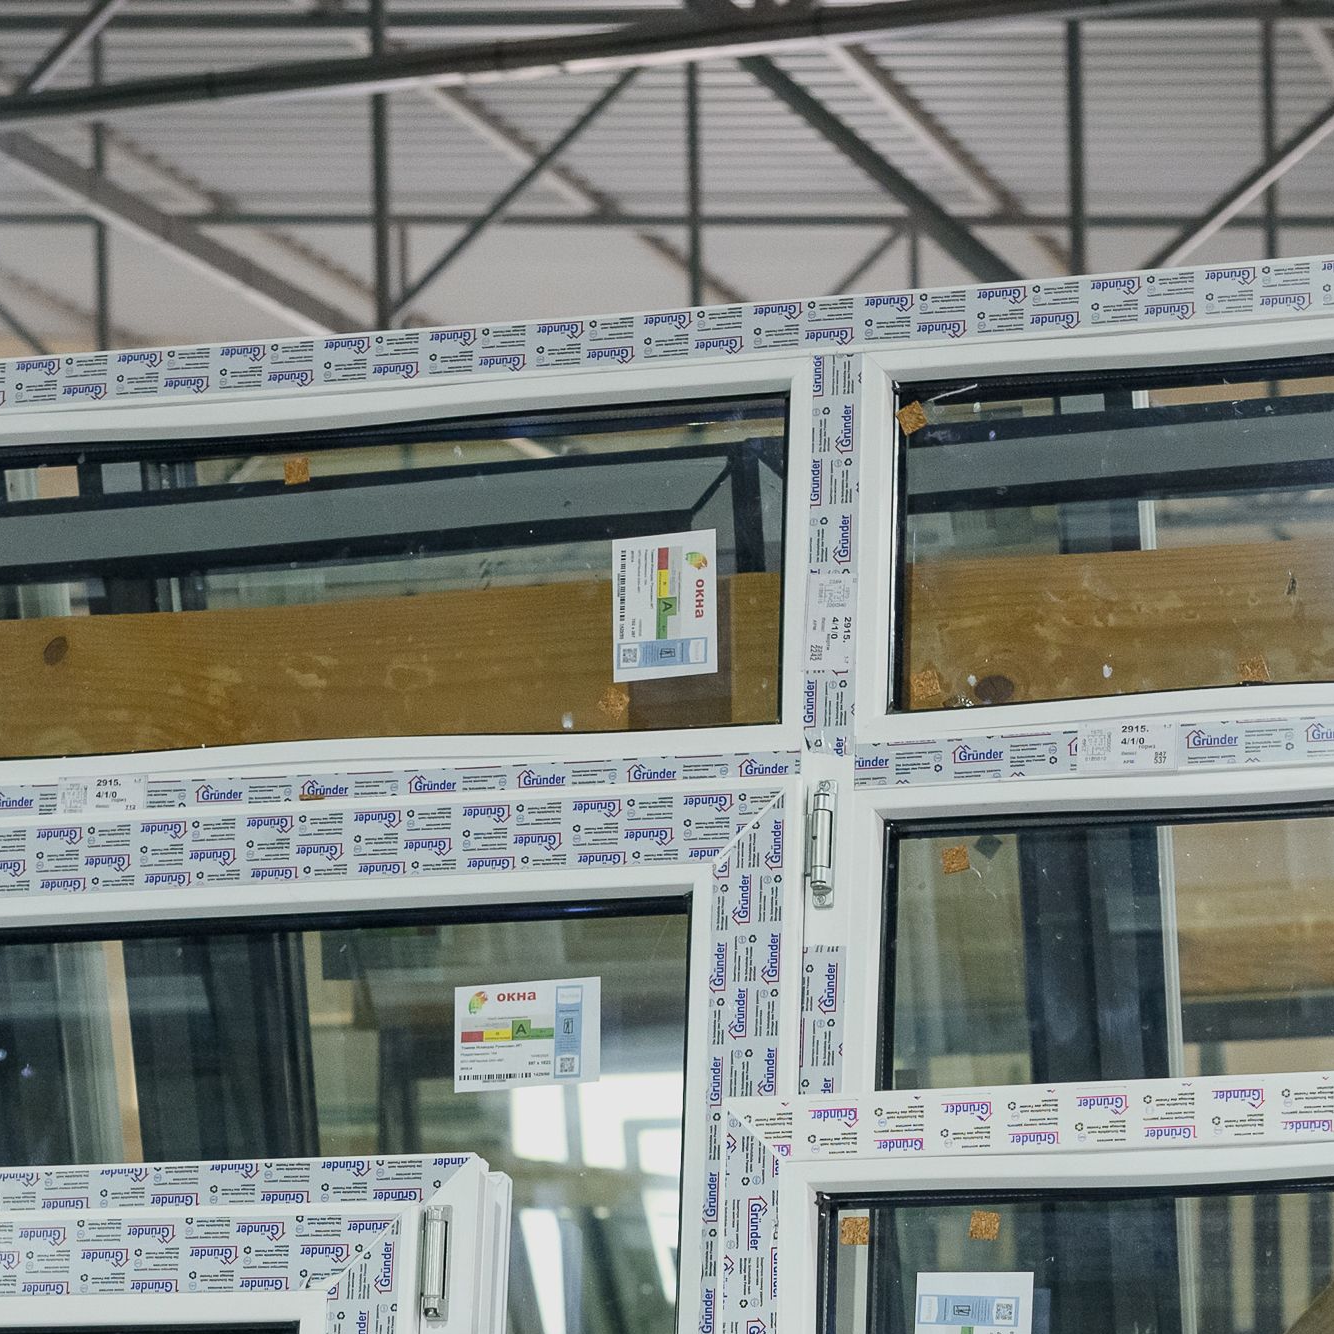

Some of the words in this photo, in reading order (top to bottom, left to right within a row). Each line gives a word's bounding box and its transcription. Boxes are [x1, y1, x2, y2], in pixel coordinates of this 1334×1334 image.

[694, 578, 706, 619] окна
[830, 616, 841, 640] 4/1/0
[843, 616, 853, 644] 2915.
[1121, 724, 1150, 734] 2915.
[1120, 737, 1146, 746] 4/1/0
[95, 790, 118, 800] 4/1/0
[496, 991, 537, 1003] окна
